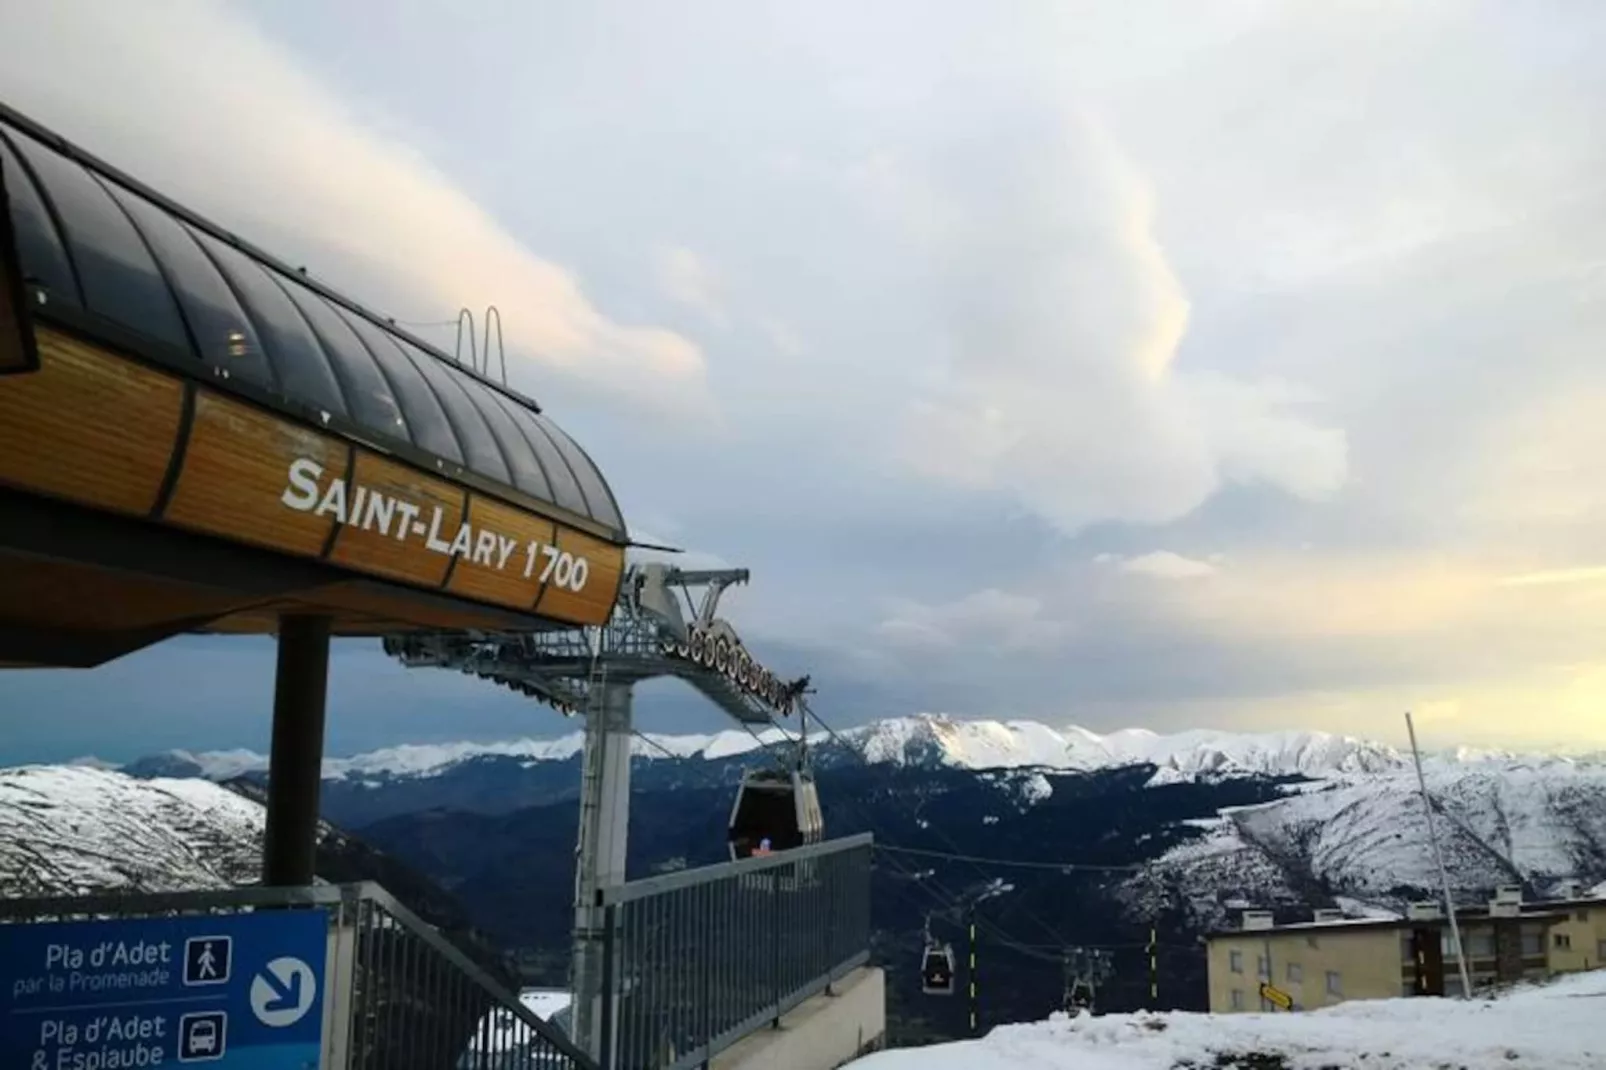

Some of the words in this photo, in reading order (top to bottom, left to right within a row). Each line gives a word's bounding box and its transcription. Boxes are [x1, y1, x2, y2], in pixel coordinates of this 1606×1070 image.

[281, 458, 516, 570] SAINT-LARY
[523, 540, 588, 592] 1700
[46, 944, 83, 969] Pla
[90, 939, 171, 966] d'Adet
[13, 976, 43, 999] par
[50, 973, 65, 992] la
[70, 967, 170, 991] Promenade
[41, 1020, 78, 1046] Pla
[85, 1015, 166, 1042] d'Adet
[31, 1049, 49, 1070] &
[57, 1043, 164, 1070] Espiaube
